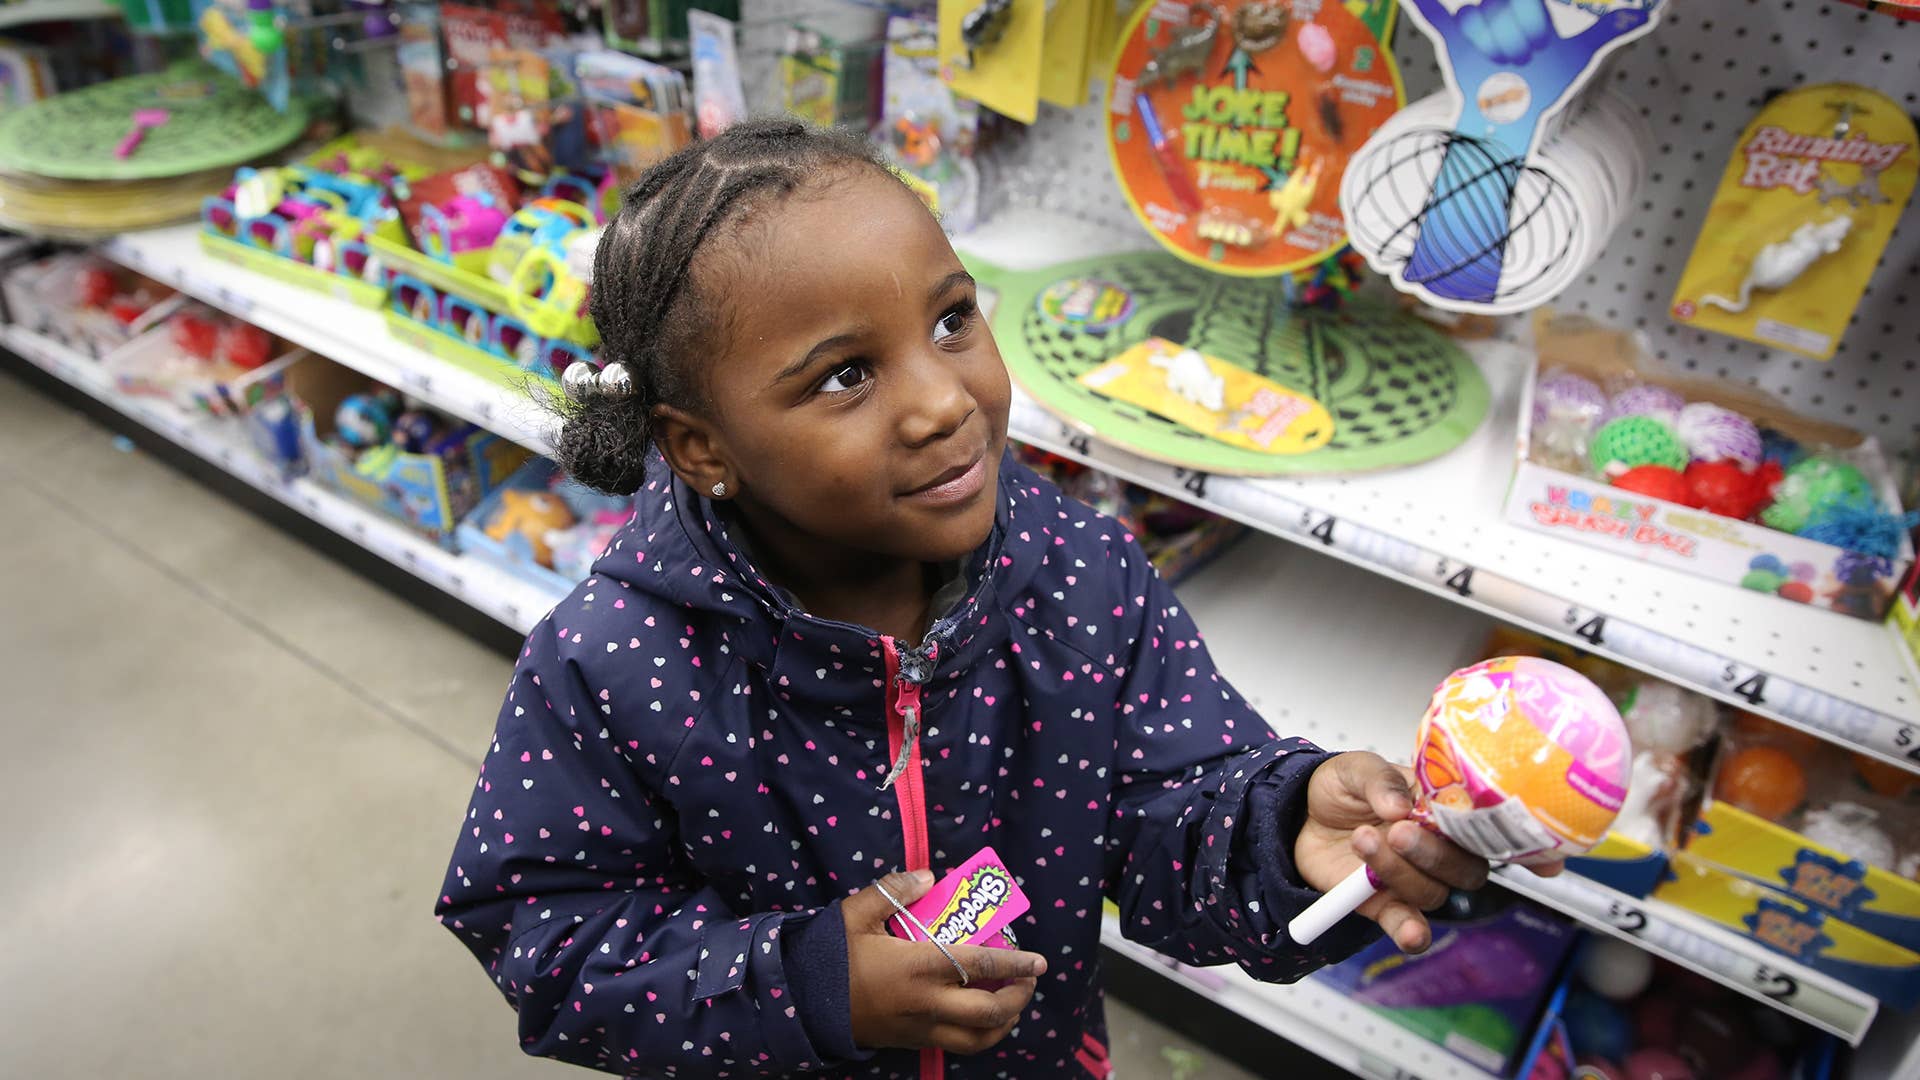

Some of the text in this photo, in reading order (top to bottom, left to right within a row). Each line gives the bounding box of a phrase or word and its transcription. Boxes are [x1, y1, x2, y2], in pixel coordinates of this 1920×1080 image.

[1183, 84, 1289, 129] JOKE
[1182, 122, 1302, 171] TIME!
[1744, 125, 1908, 171] Running
[1741, 150, 1821, 195] Rat
[1302, 506, 1336, 546] $4
[1435, 556, 1475, 597] $4
[1563, 606, 1607, 646] $4
[1720, 662, 1768, 706] $4
[936, 874, 1006, 945] Shopkins
[1608, 900, 1647, 937] $2
[1753, 963, 1798, 1006] $2
